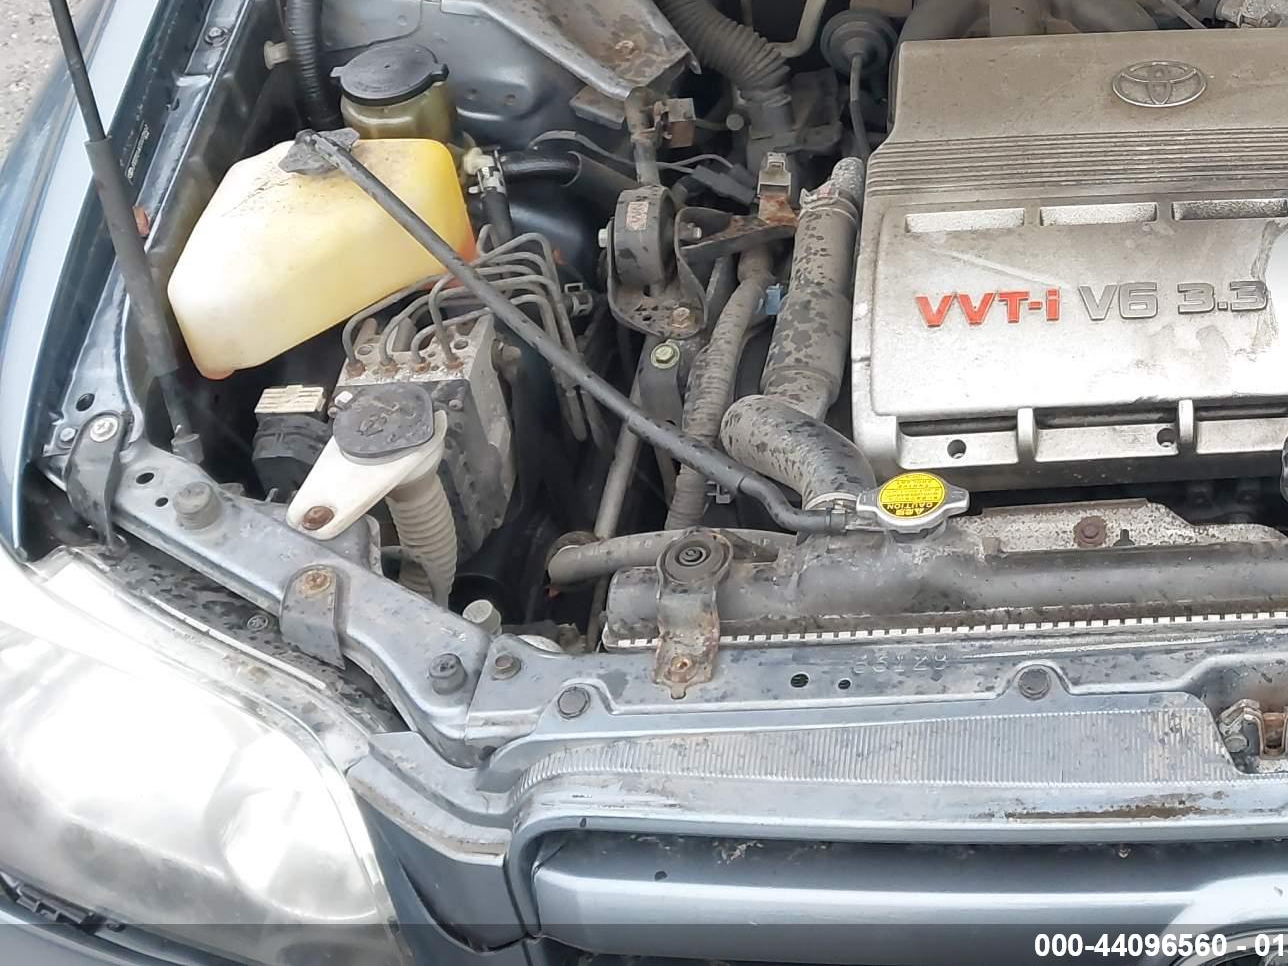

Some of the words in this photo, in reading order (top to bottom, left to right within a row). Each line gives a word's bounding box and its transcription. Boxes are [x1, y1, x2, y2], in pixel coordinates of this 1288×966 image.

[914, 288, 1062, 328] VVT-i
[1078, 282, 1158, 321] V6
[1177, 280, 1269, 314] 3.3
[887, 502, 933, 510] CAUTION
